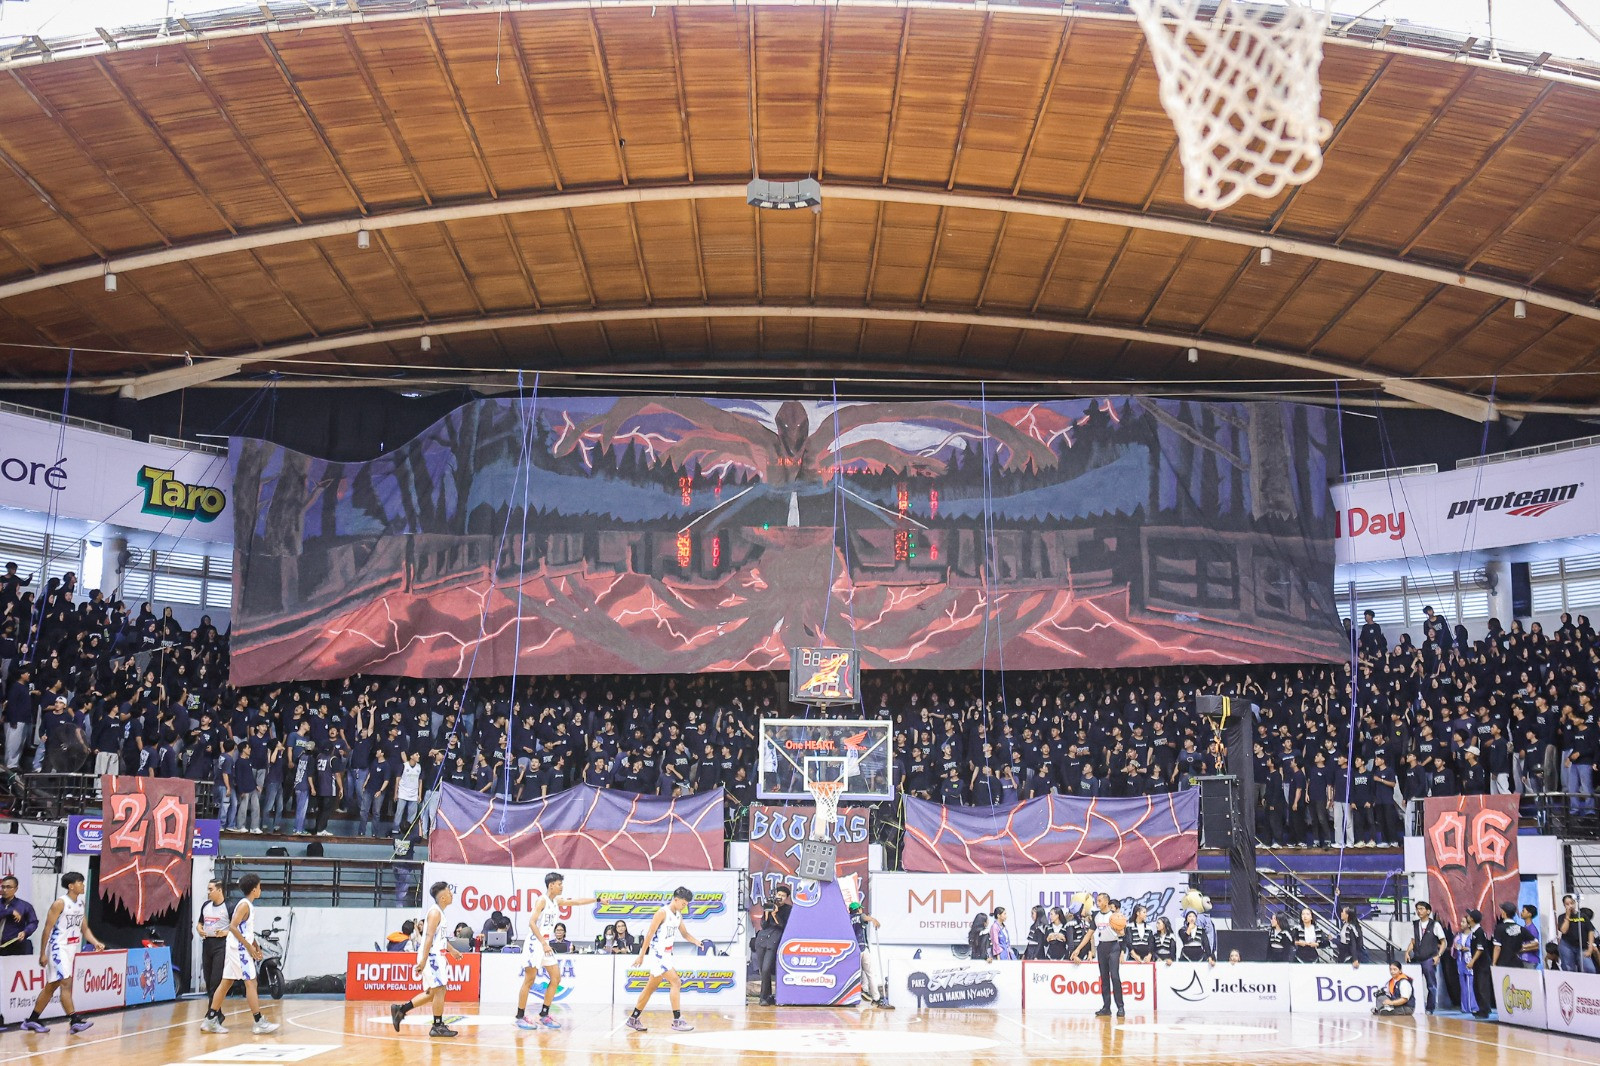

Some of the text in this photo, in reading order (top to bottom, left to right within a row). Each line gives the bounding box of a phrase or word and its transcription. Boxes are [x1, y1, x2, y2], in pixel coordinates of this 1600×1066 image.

[142, 466, 226, 516] Taro
[1447, 483, 1579, 519] proteam
[1348, 507, 1405, 540] Day
[785, 740, 804, 750] One
[109, 793, 189, 854] 20
[751, 811, 868, 843] BOOAS
[1428, 808, 1512, 869] 06
[461, 885, 522, 913] Good
[625, 892, 663, 900] WORTH
[907, 889, 994, 914] MPM
[411, 963, 471, 982] CAM
[799, 956, 818, 966] DBL
[911, 979, 926, 988] PAKE
[927, 969, 1001, 991] STREET
[1050, 974, 1104, 995] Good
[1212, 978, 1277, 994] Jackson
[1316, 976, 1384, 1003] Bior
[928, 991, 944, 1003] GAYA
[945, 990, 966, 1001] MAKIN
